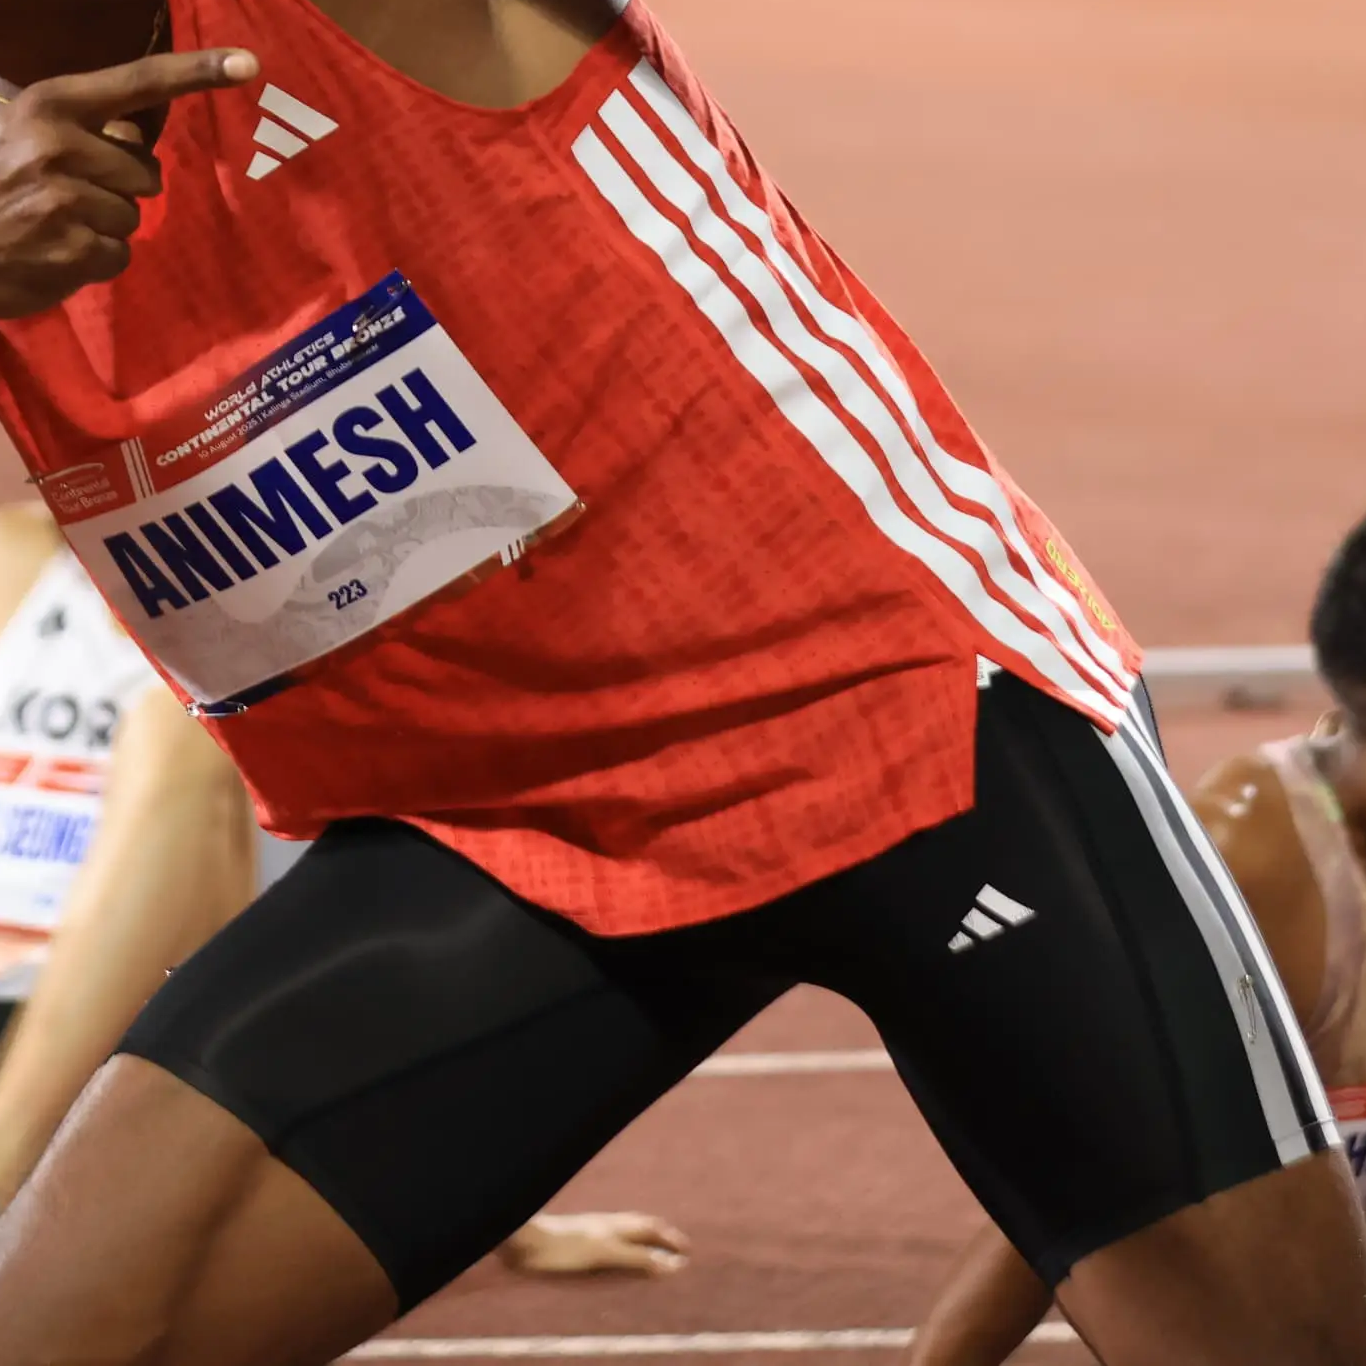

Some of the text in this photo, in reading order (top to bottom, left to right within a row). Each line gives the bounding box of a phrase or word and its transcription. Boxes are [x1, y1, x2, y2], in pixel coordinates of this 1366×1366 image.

[156, 305, 406, 467] CONTINENTAL TOUR BRONZE
[260, 331, 335, 390] ATHLETICS
[209, 433, 240, 455] August
[236, 417, 259, 437] 2025
[262, 397, 292, 421] Kalinga
[103, 367, 477, 619] ANIMESH
[328, 579, 368, 611] 223
